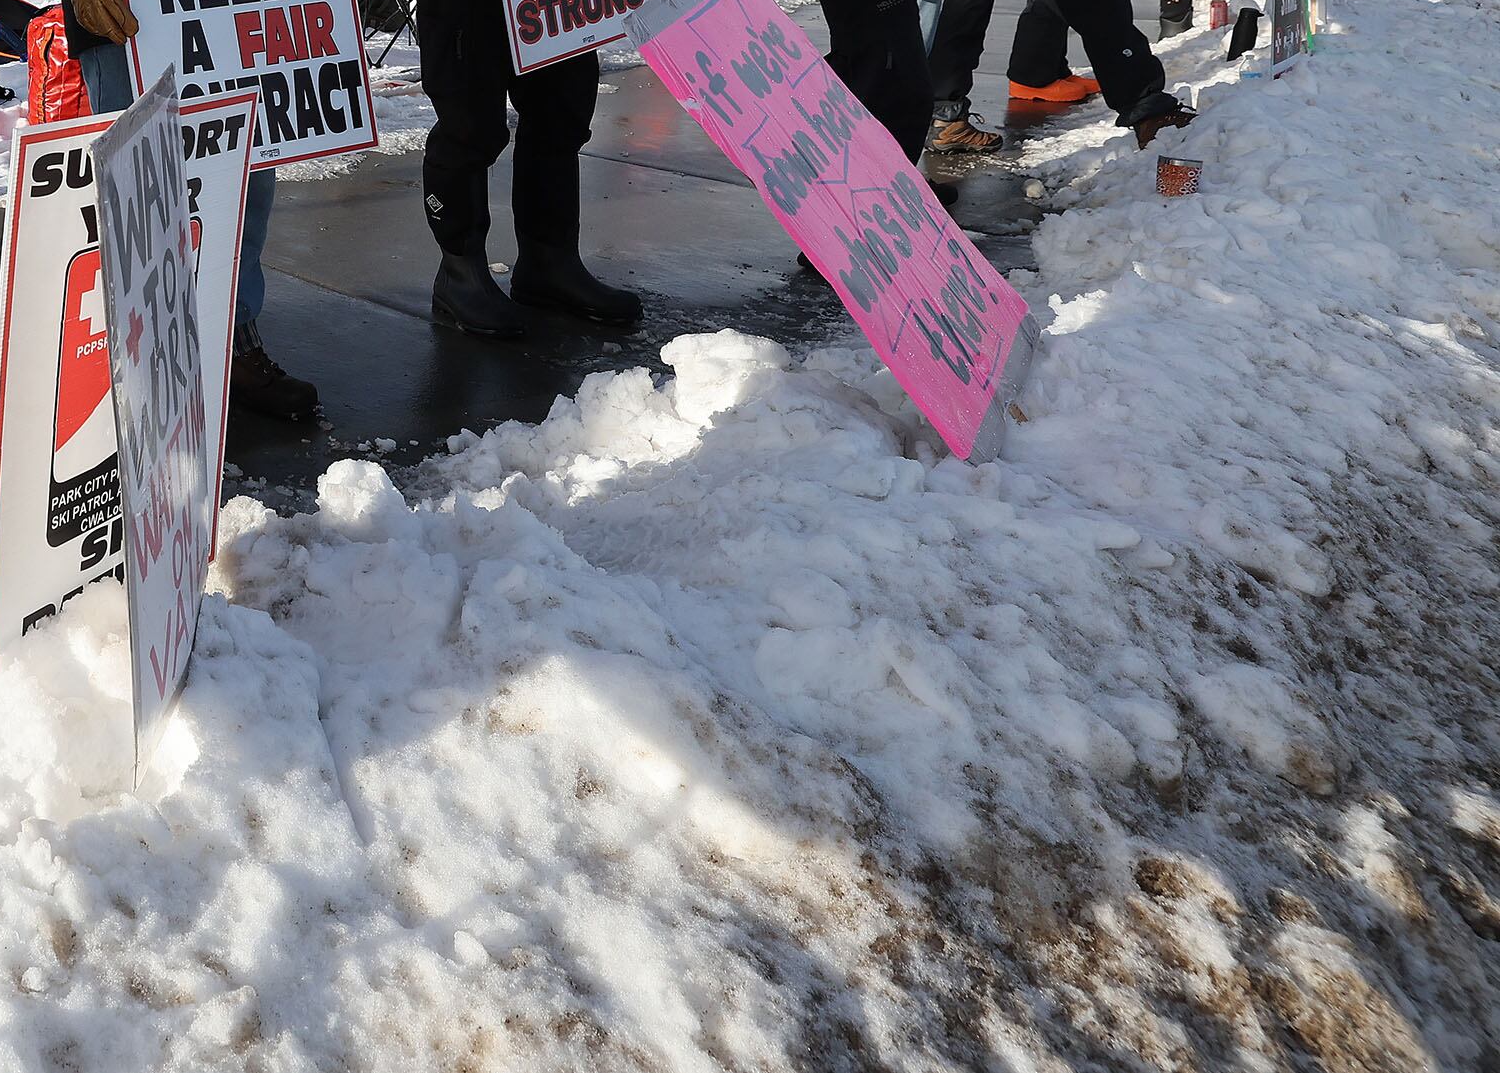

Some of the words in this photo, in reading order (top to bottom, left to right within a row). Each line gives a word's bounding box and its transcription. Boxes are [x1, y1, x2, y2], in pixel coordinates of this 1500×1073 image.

[181, 19, 215, 75] A
[234, 1, 341, 70] FAIR
[685, 50, 743, 128] if
[750, 129, 831, 216] down
[838, 203, 914, 314] who's
[886, 171, 942, 235] up
[143, 248, 176, 363] TO
[913, 238, 999, 385] there?
[51, 485, 81, 512] PARK
[84, 473, 108, 495] CITY
[51, 510, 70, 530] SKI
[72, 491, 115, 521] PATROL
[80, 511, 105, 532] CWA
